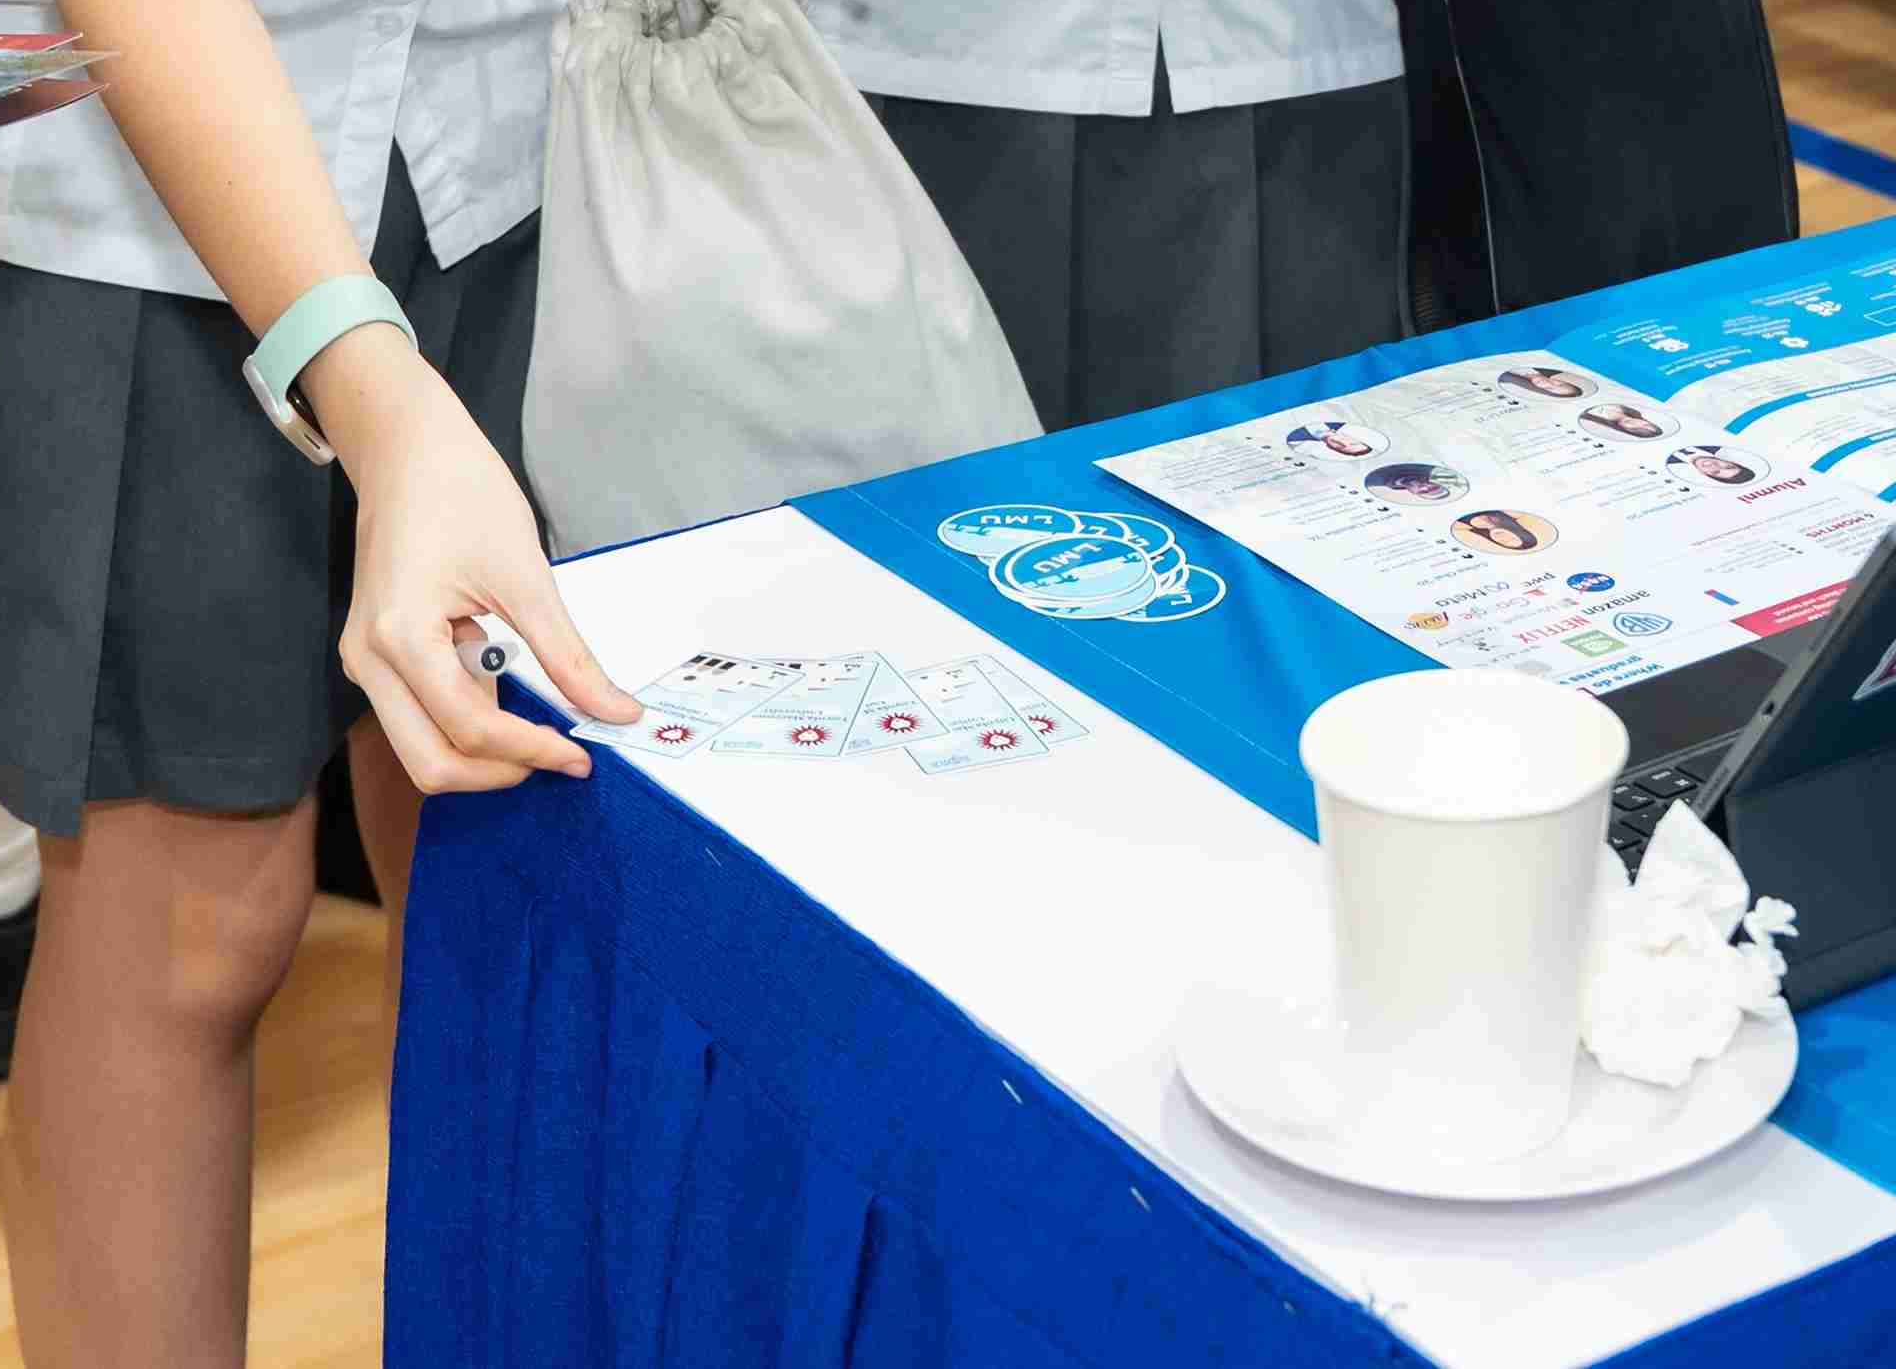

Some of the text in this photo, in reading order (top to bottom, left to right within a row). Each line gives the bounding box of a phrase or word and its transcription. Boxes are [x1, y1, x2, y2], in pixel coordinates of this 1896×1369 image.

[1736, 477, 1808, 505] Alumni
[980, 514, 1054, 526] LMU
[1033, 543, 1102, 574] LMU
[1435, 572, 1557, 609] pwc Meta
[1582, 590, 1652, 617] amazon
[1512, 615, 1592, 645] NETFLIX
